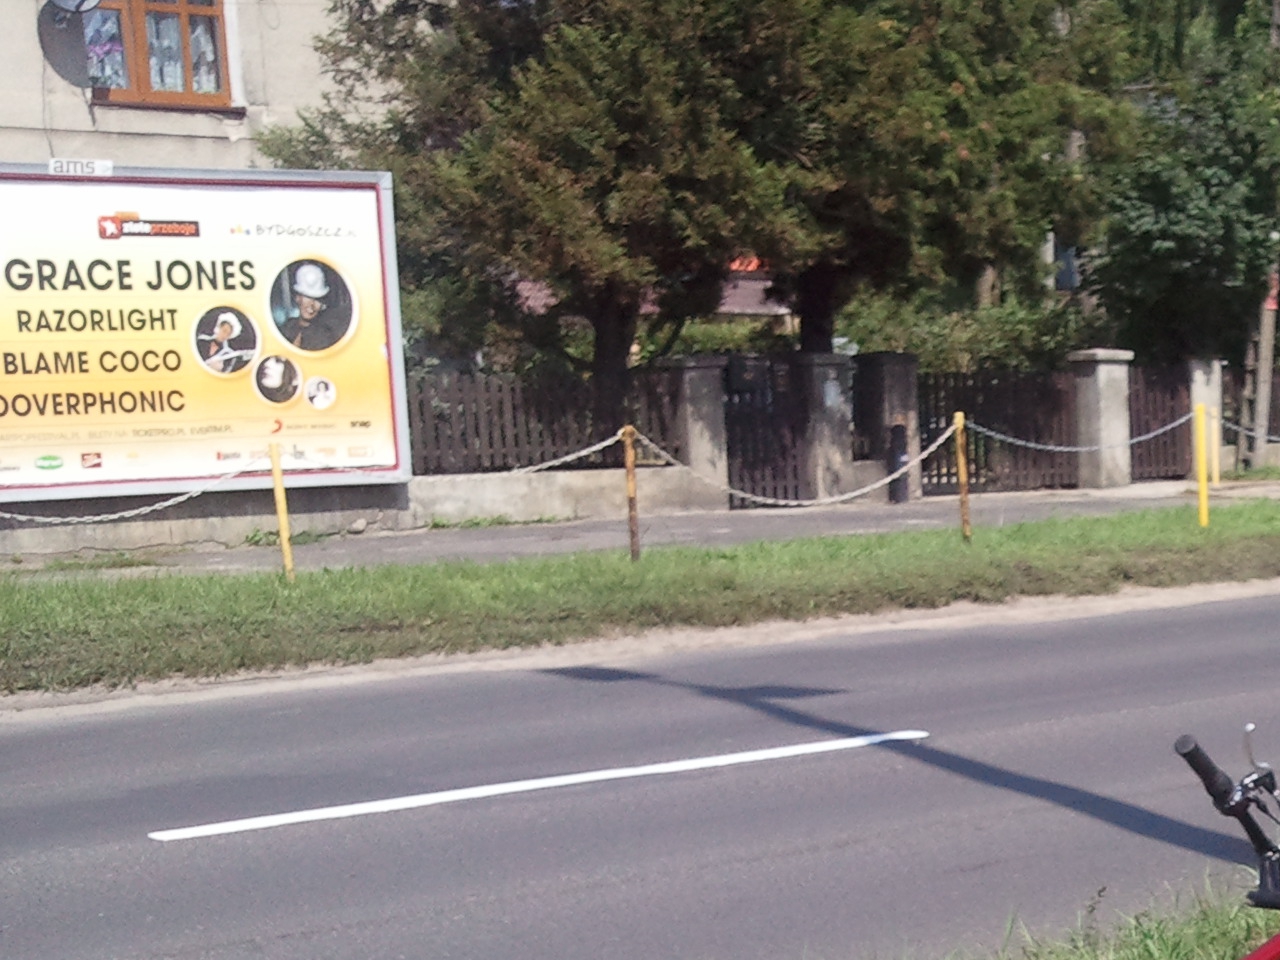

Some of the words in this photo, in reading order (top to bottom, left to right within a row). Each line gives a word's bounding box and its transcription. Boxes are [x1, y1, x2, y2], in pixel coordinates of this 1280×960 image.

[53, 160, 95, 174] ams
[4, 258, 133, 291] GRACE
[146, 260, 256, 291] JONES
[17, 308, 177, 333] RAZORLIGHT
[3, 350, 90, 375] BLAME
[99, 350, 182, 373] COCO
